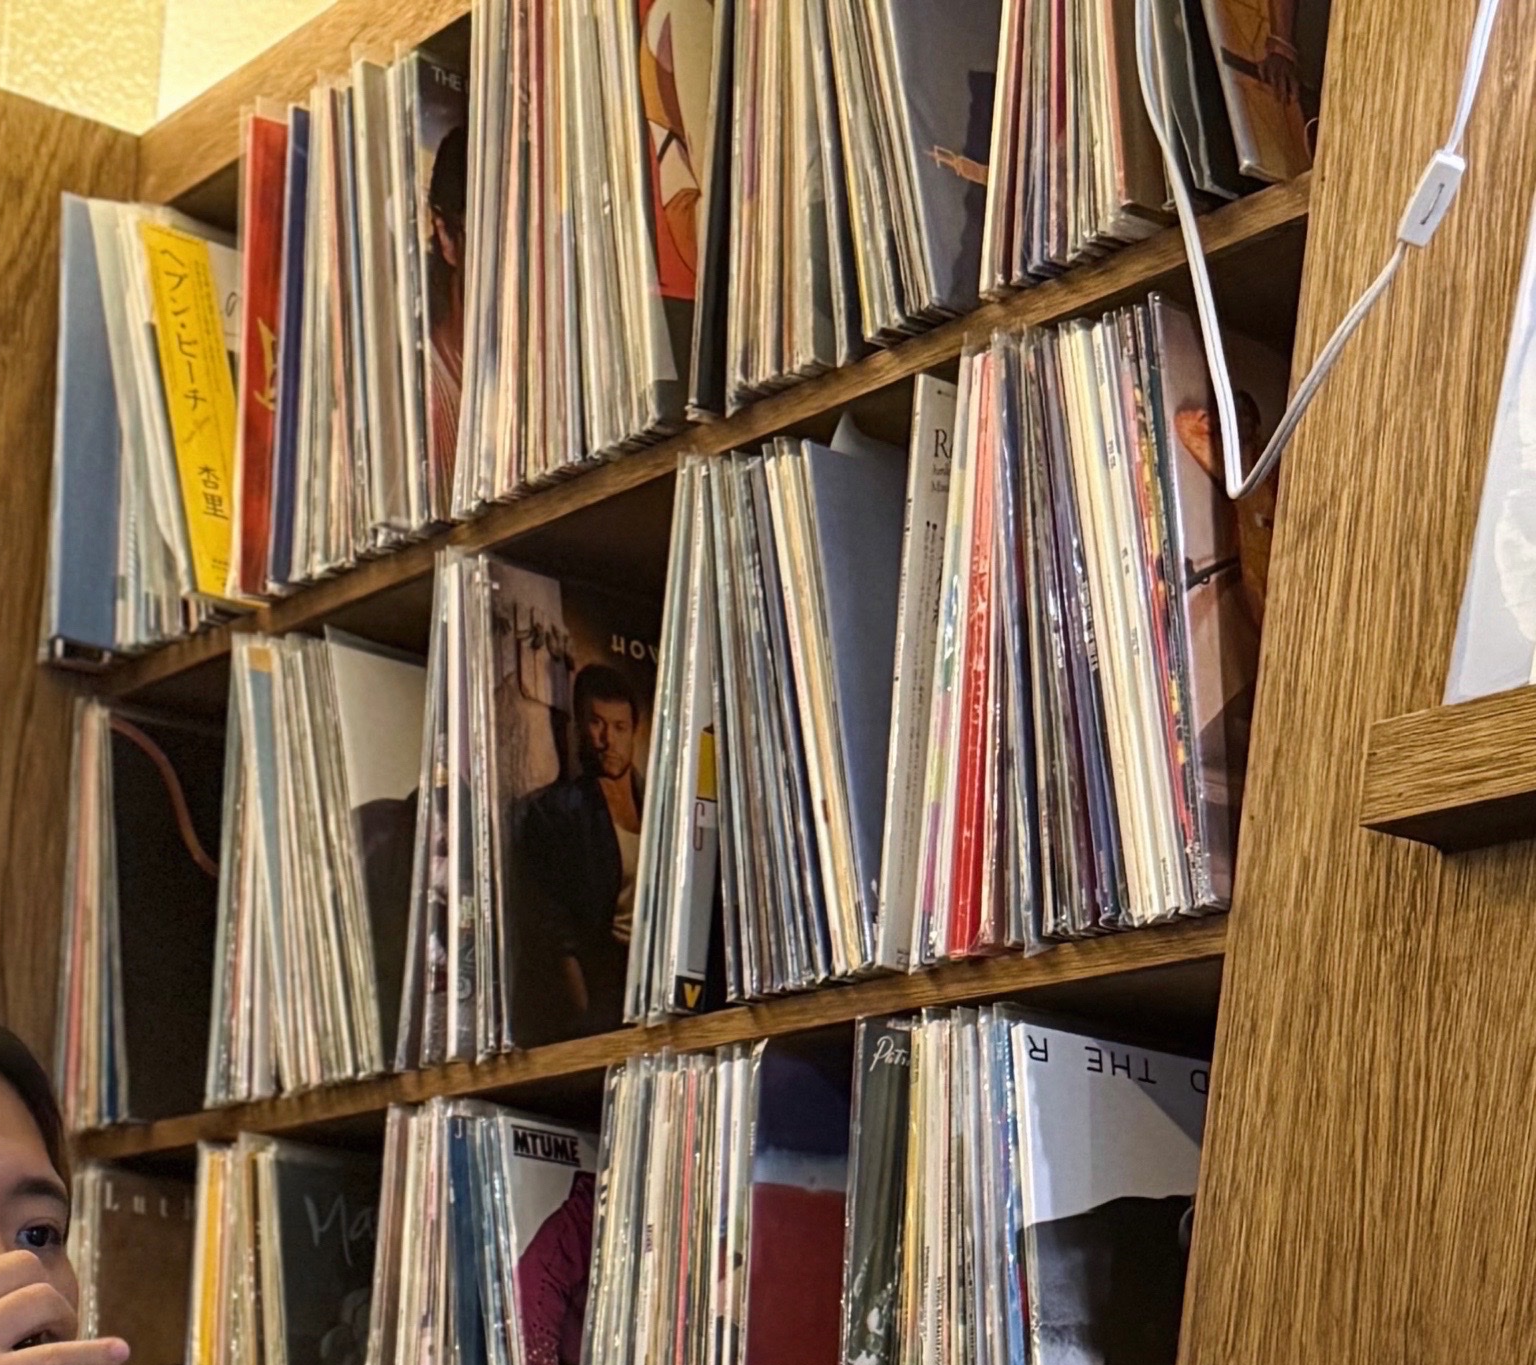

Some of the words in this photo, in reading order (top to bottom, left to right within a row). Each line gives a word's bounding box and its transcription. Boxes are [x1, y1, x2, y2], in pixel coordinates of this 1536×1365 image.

[430, 65, 462, 92] THE
[1084, 1045, 1157, 1085] THE
[513, 1128, 581, 1165] MTUME
